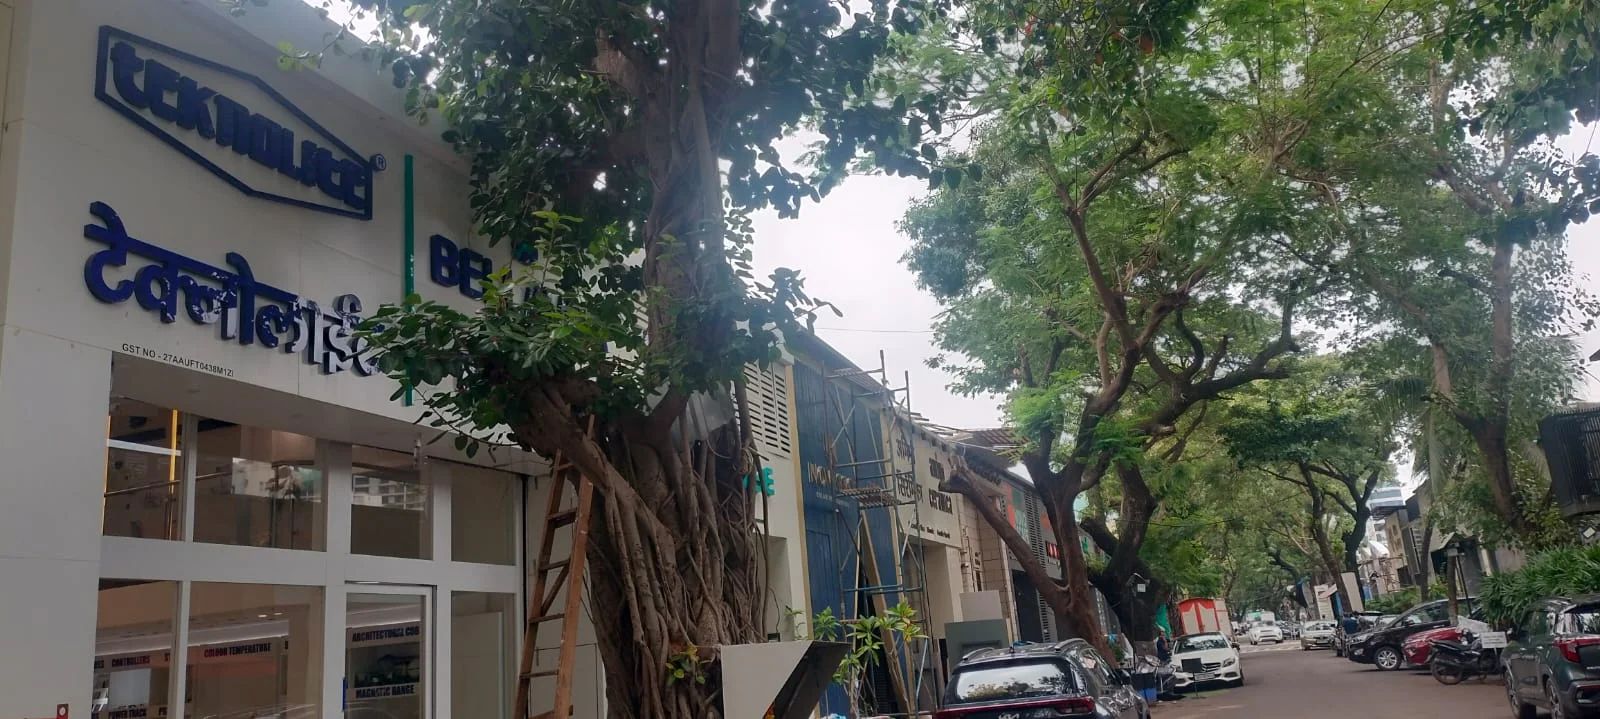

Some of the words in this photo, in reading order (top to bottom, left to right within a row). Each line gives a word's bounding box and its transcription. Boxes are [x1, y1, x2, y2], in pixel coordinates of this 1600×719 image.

[122, 343, 141, 354] GST
[142, 347, 156, 358] NO
[204, 647, 228, 658] COLOUR
[229, 643, 271, 656] TEMPERATURE
[111, 656, 150, 668] CONTROLLERS
[356, 687, 391, 699] MAGNETIC
[392, 684, 415, 696] RANGE
